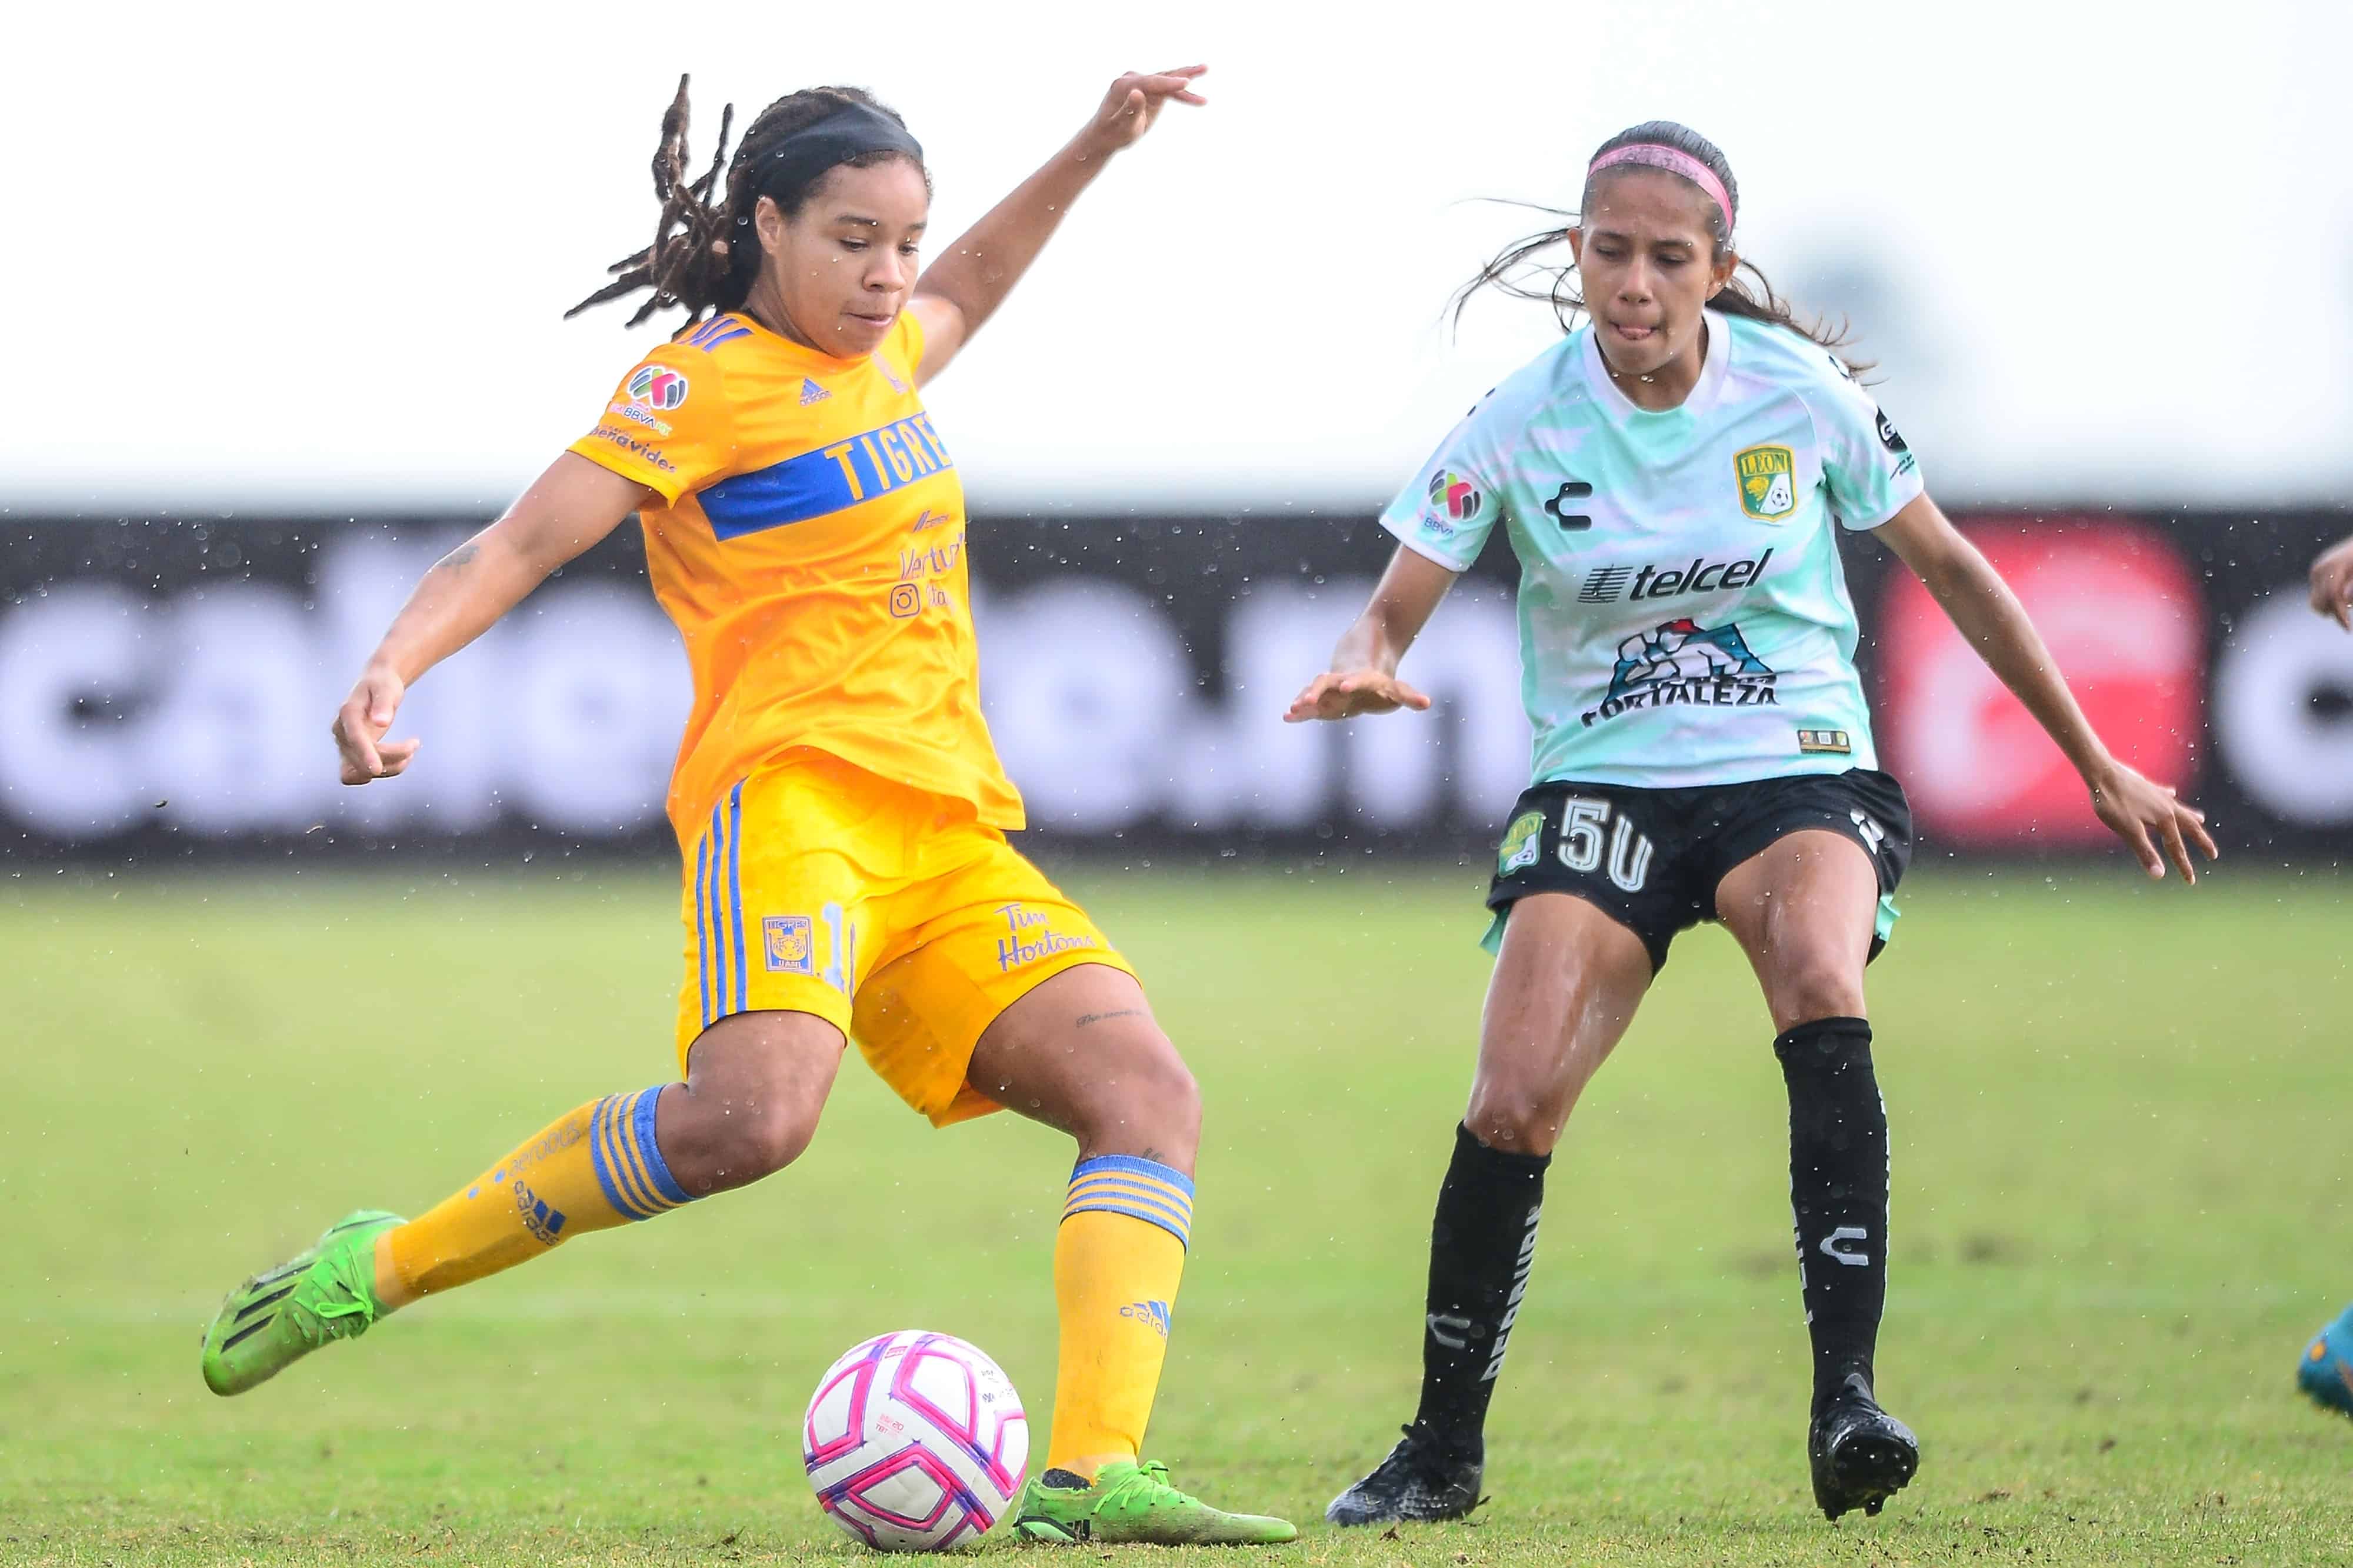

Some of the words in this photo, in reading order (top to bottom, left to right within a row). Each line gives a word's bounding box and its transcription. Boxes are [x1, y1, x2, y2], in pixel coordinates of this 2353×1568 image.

[624, 407, 655, 429] BBVA
[1424, 516, 1454, 538] BBVA
[1629, 547, 1774, 602] telcel
[994, 903, 1049, 932] Tim
[998, 930, 1095, 972] Hortons
[514, 1180, 559, 1246] adidas
